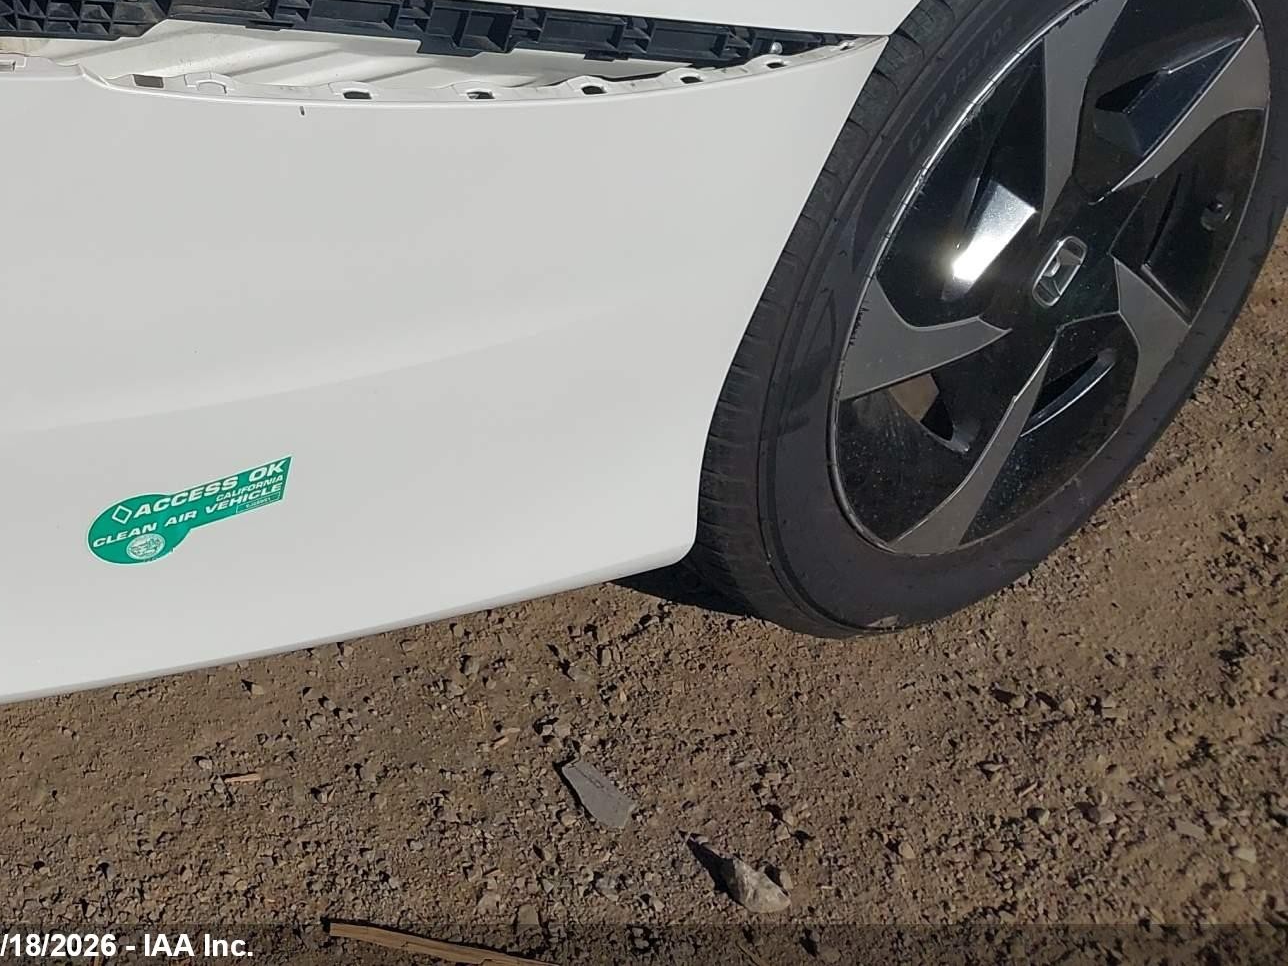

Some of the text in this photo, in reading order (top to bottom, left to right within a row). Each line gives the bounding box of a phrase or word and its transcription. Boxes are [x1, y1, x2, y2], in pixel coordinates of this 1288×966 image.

[92, 522, 158, 548] CLEAN
[164, 509, 198, 527] AIR
[205, 482, 283, 514] VEHICLE
[133, 475, 240, 519] ACCESS
[248, 459, 287, 483] OK
[215, 474, 283, 502] CALIFORNIA
